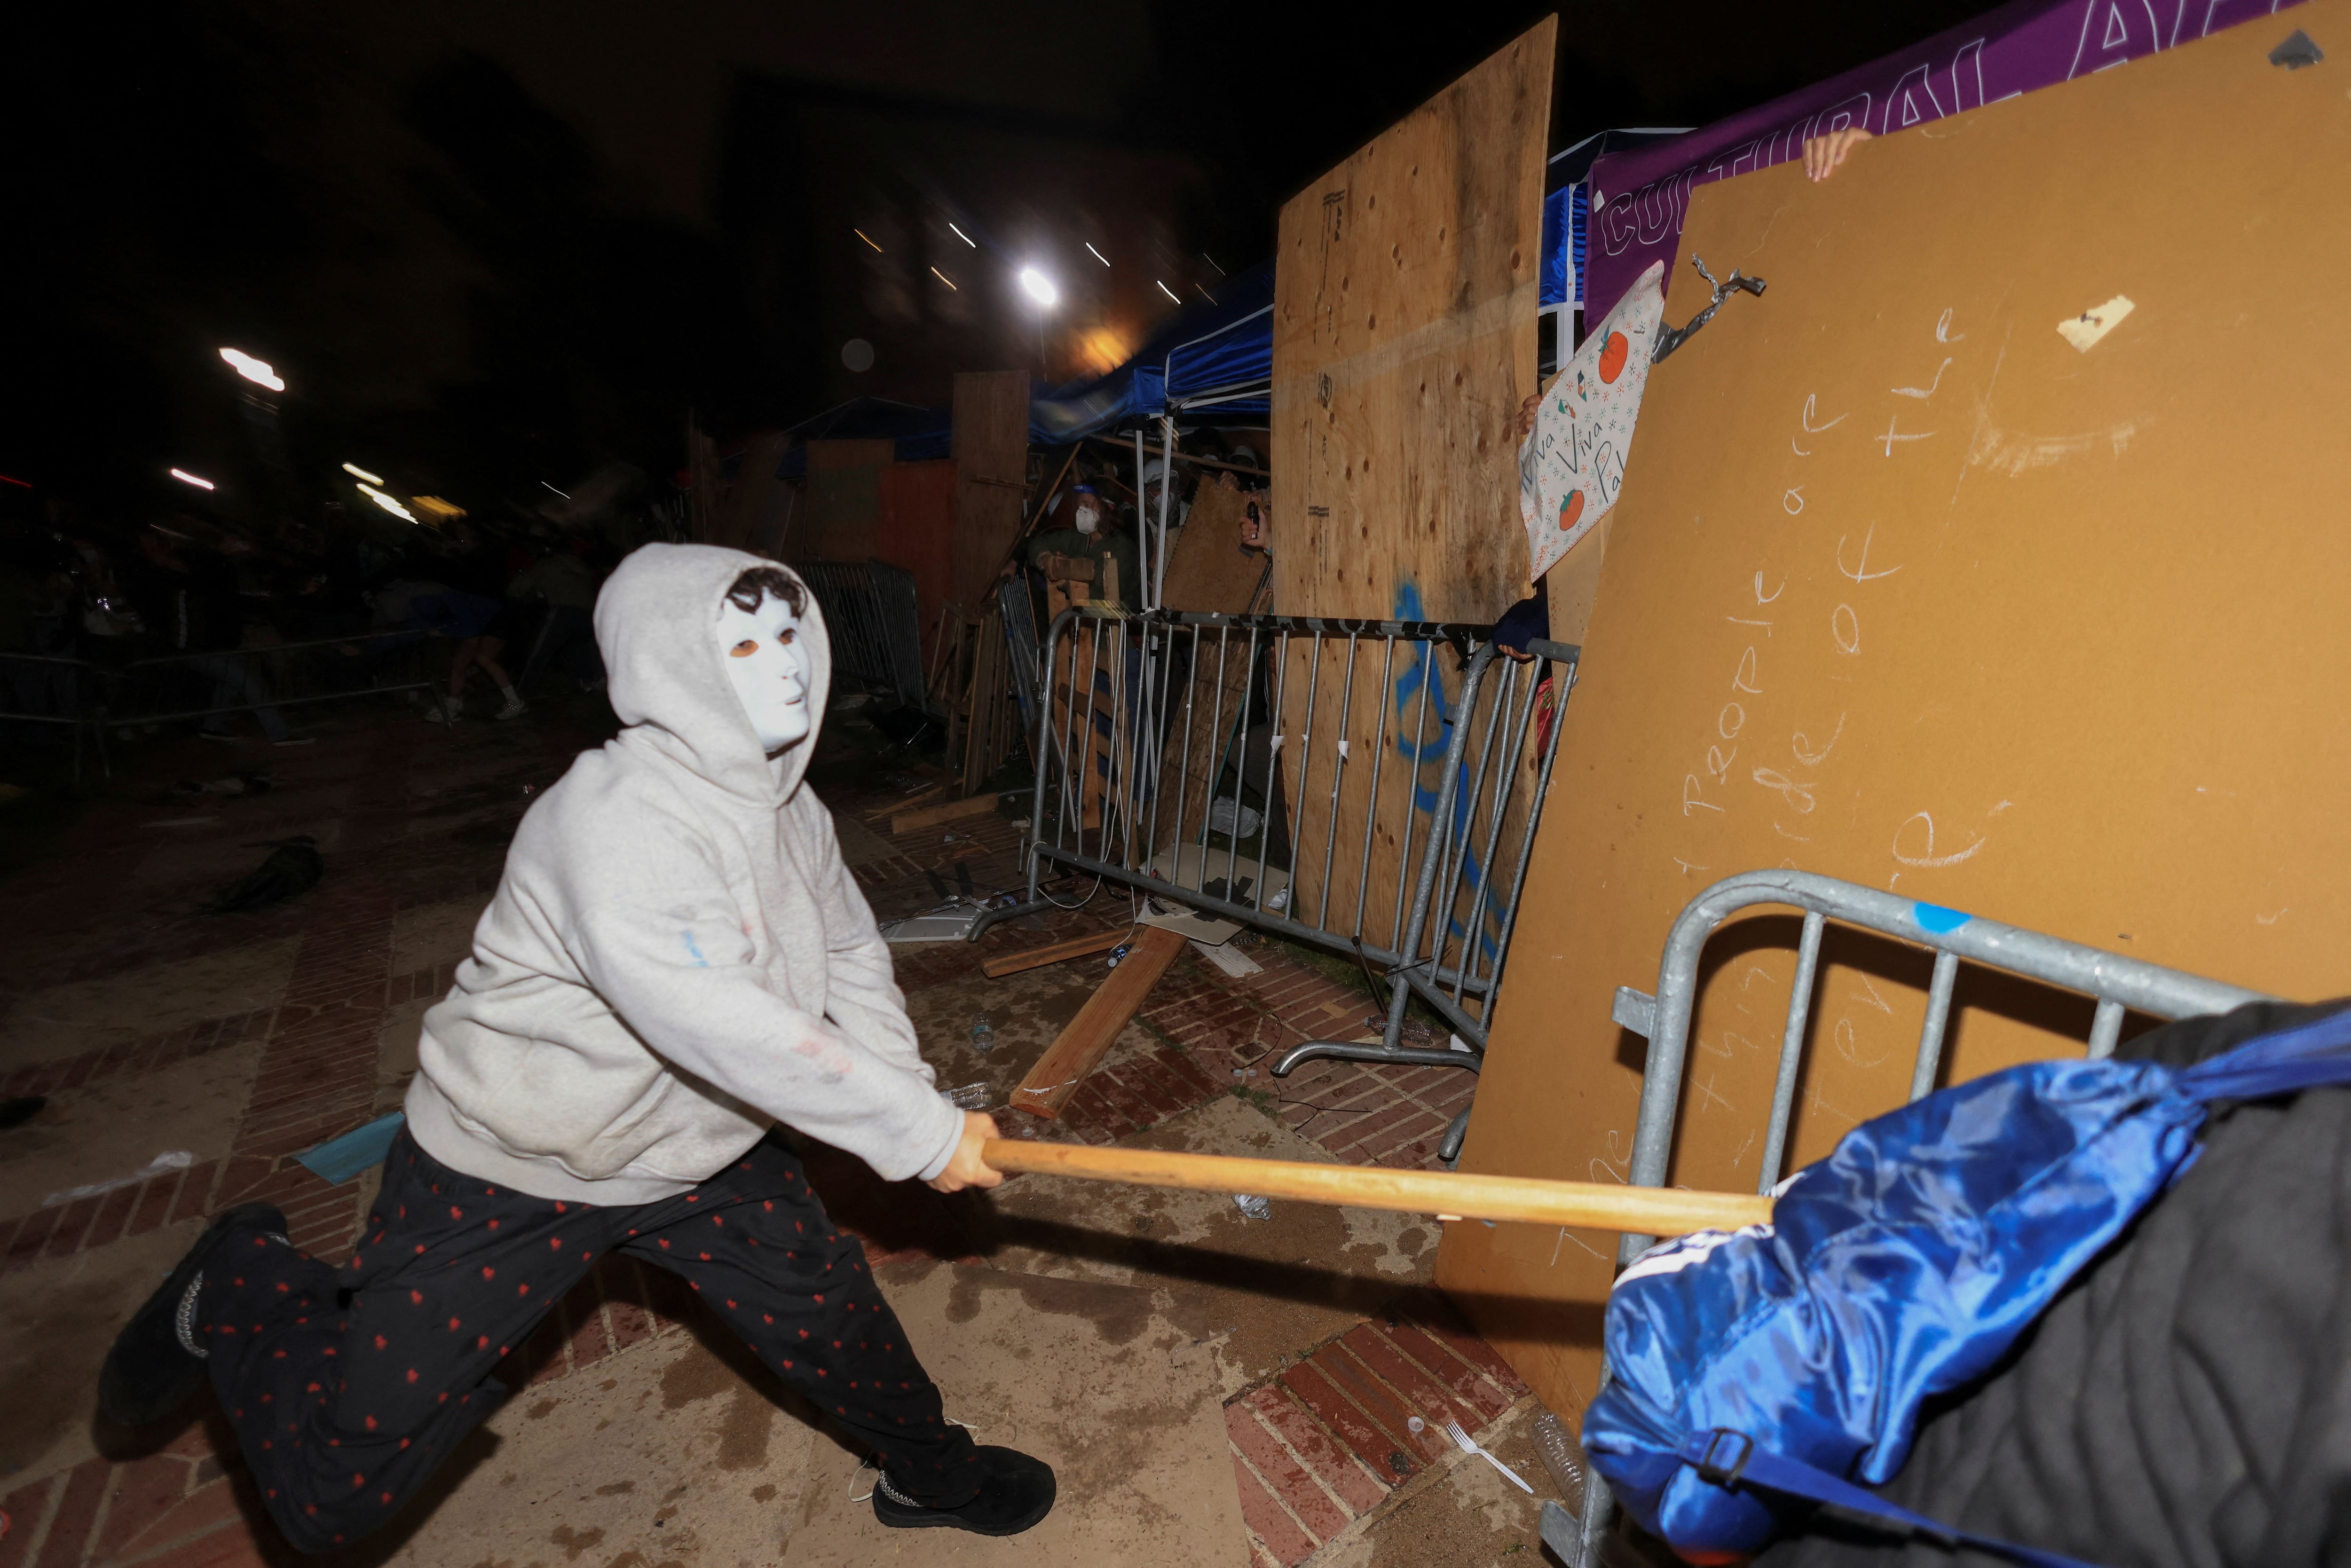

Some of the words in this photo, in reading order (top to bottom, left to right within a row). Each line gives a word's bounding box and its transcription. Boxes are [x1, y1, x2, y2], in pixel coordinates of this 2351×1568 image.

[1556, 422, 1602, 474] Viva
[1783, 393, 1851, 516] are
[1832, 519, 1903, 655] of
[1875, 307, 1966, 457] the
